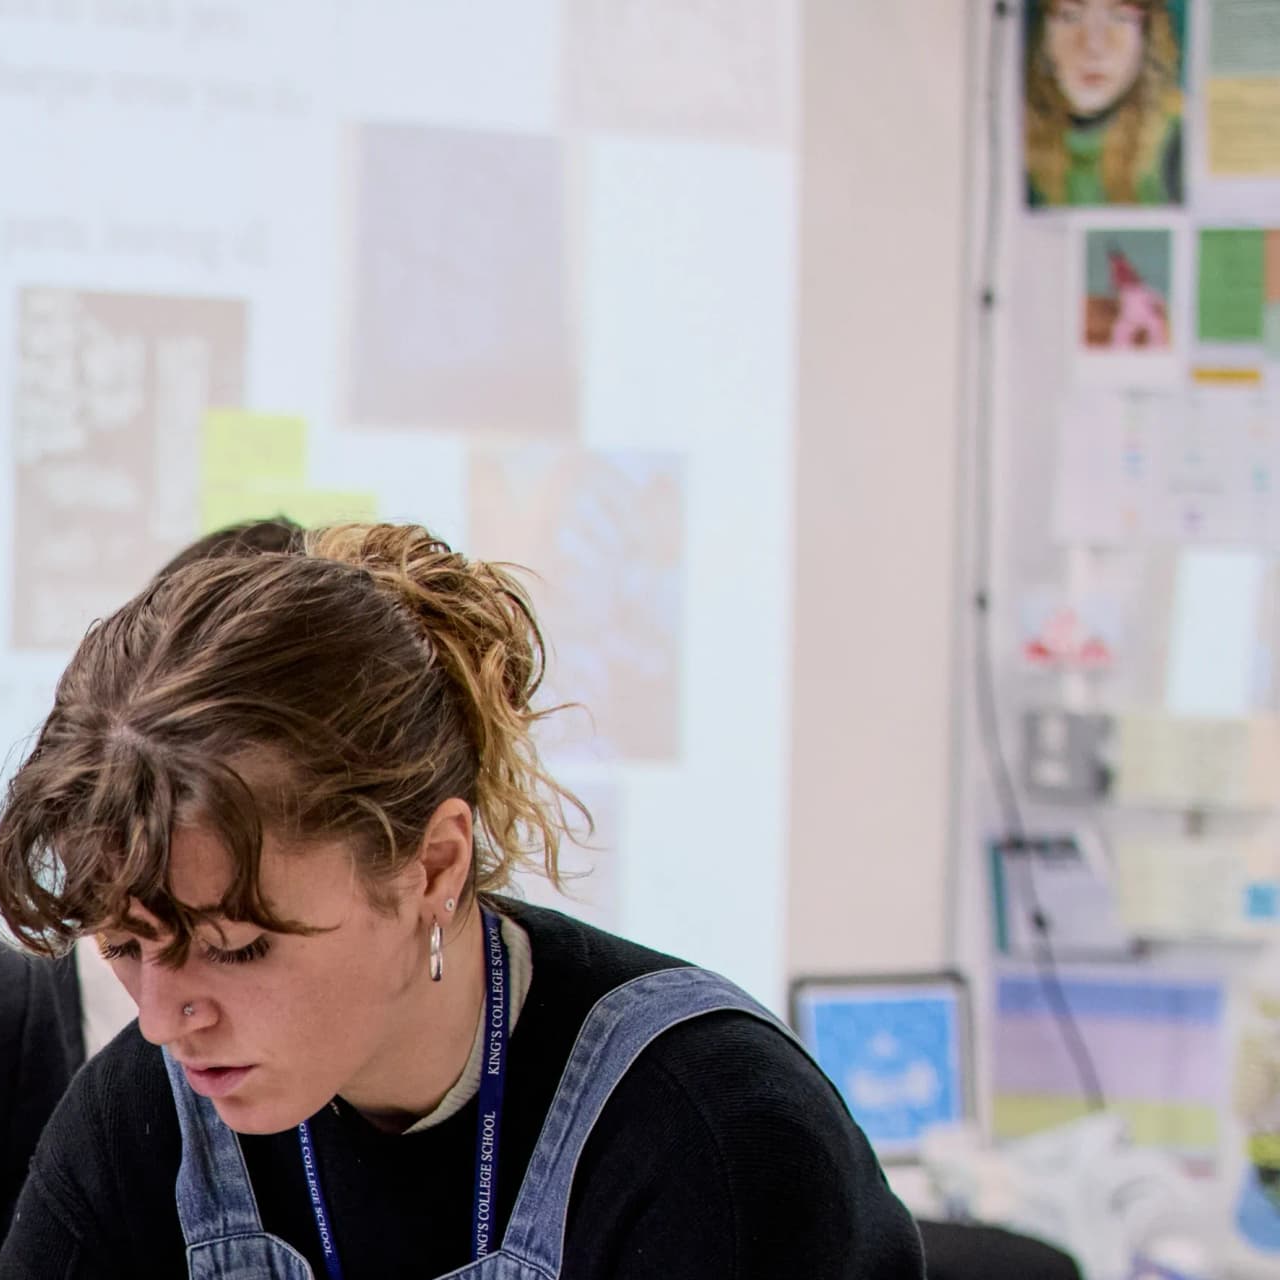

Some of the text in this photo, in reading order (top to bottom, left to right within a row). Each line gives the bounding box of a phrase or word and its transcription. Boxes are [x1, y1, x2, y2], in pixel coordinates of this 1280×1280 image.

[488, 928, 504, 1075] KING'S COLLEGE SCHOOL
[480, 1111, 496, 1161] SCHOOL
[302, 1146, 321, 1205] COLLEGE
[314, 1207, 333, 1257] SCHOOL
[478, 1164, 493, 1221] COLLEGE
